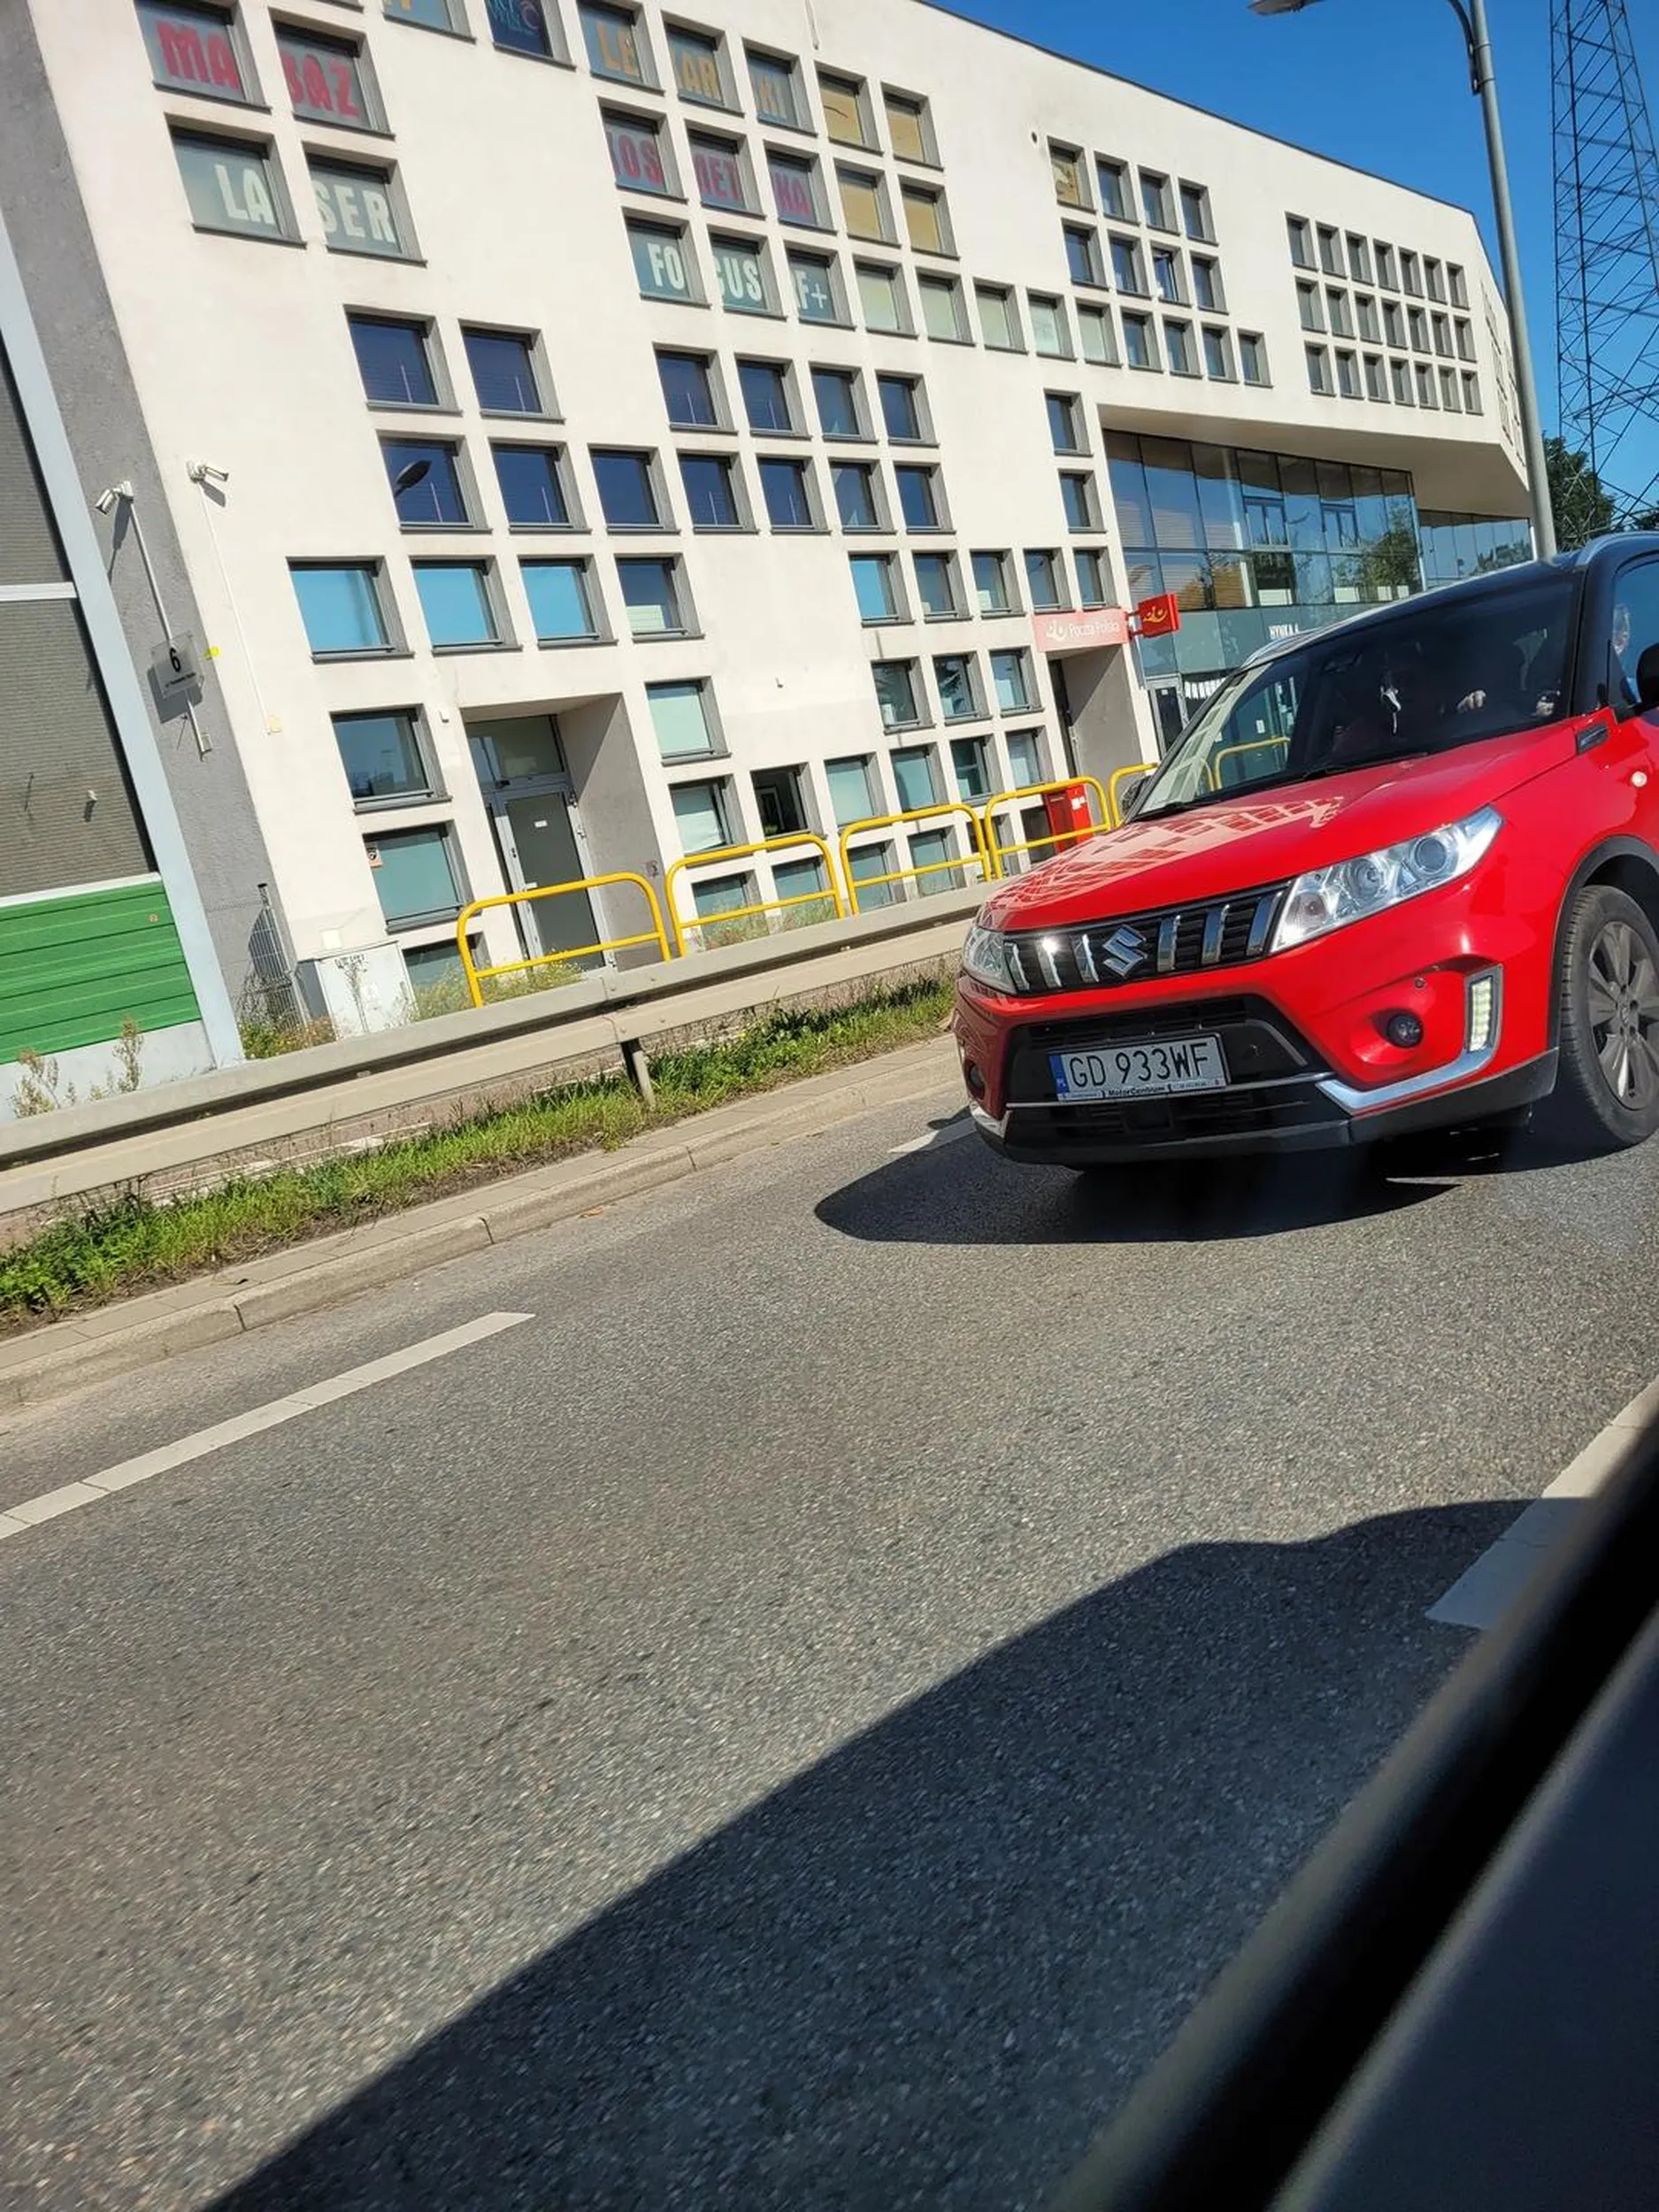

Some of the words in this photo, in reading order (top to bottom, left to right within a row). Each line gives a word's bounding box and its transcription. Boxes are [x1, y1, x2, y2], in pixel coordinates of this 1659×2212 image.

[170, 648, 180, 672] 6
[1069, 1055, 1106, 1087] GD
[1116, 1042, 1208, 1084] 933WF
